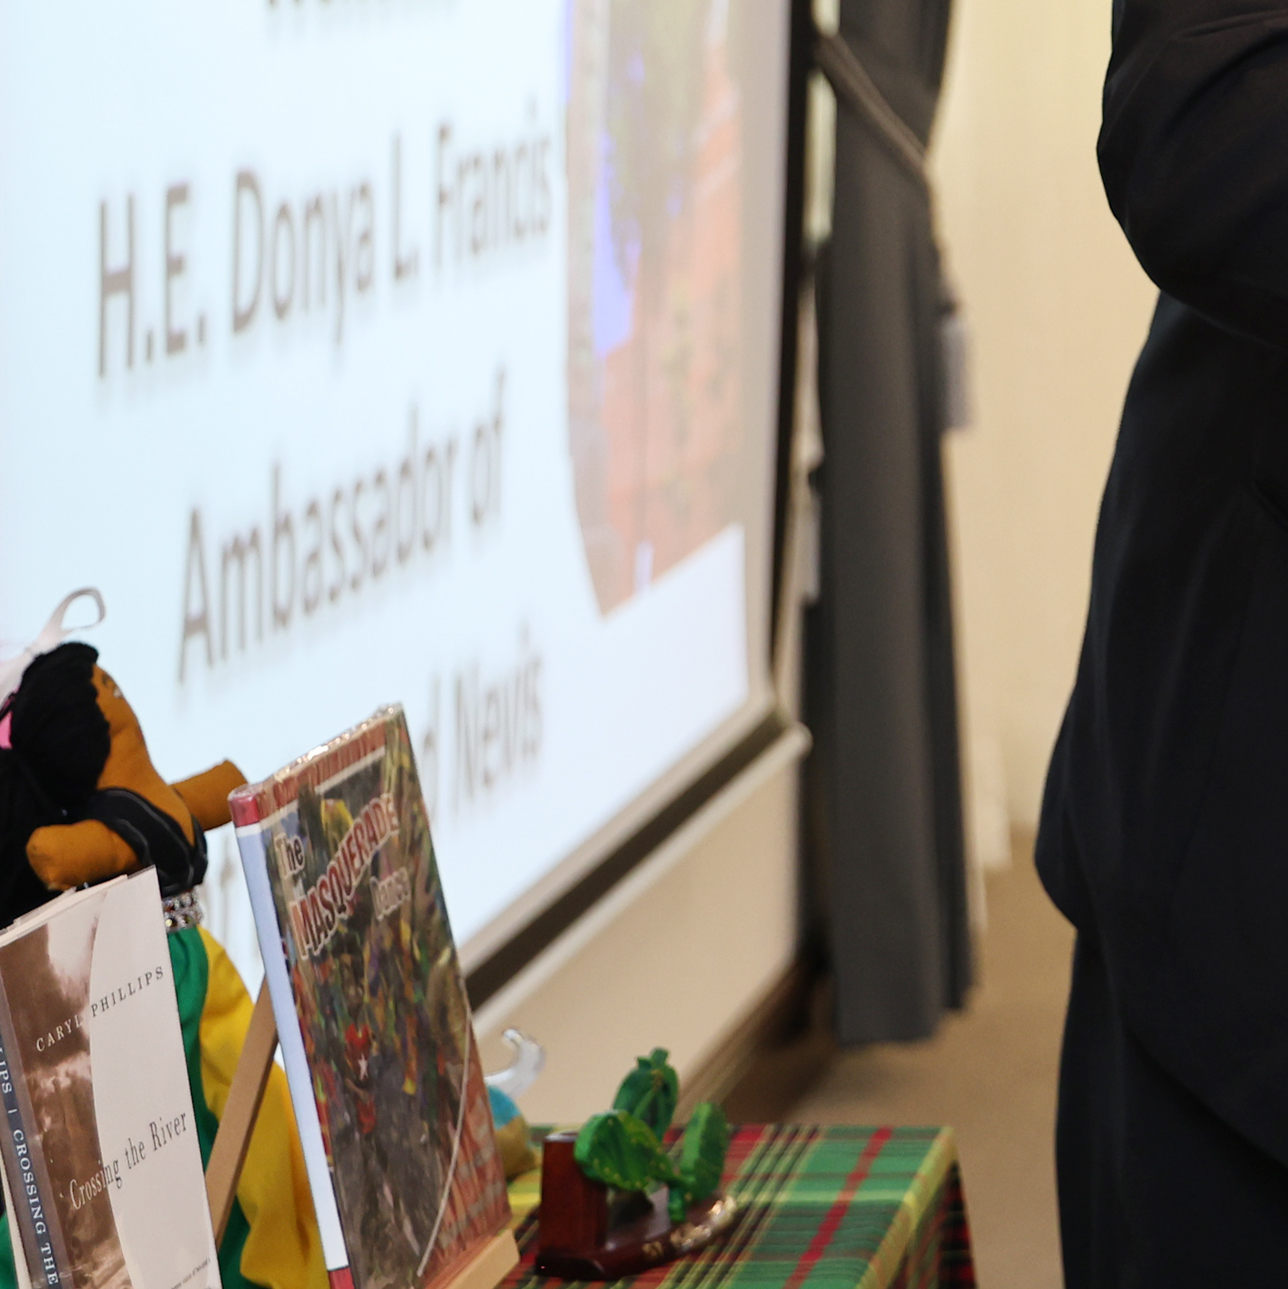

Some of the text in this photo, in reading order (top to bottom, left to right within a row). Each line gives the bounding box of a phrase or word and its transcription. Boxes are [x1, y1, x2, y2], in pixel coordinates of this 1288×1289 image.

[97, 100, 553, 379] H.E. Donya L. Francis
[178, 363, 507, 685] Ambassador of
[453, 619, 545, 801] Nevis
[275, 834, 304, 879] The
[290, 794, 399, 959] MASQUERADE
[36, 965, 165, 1053] CARYL PHILLIPS
[12, 1127, 48, 1236] CROSSING
[40, 1243, 60, 1287] THE
[68, 1111, 189, 1211] Crossing the River
